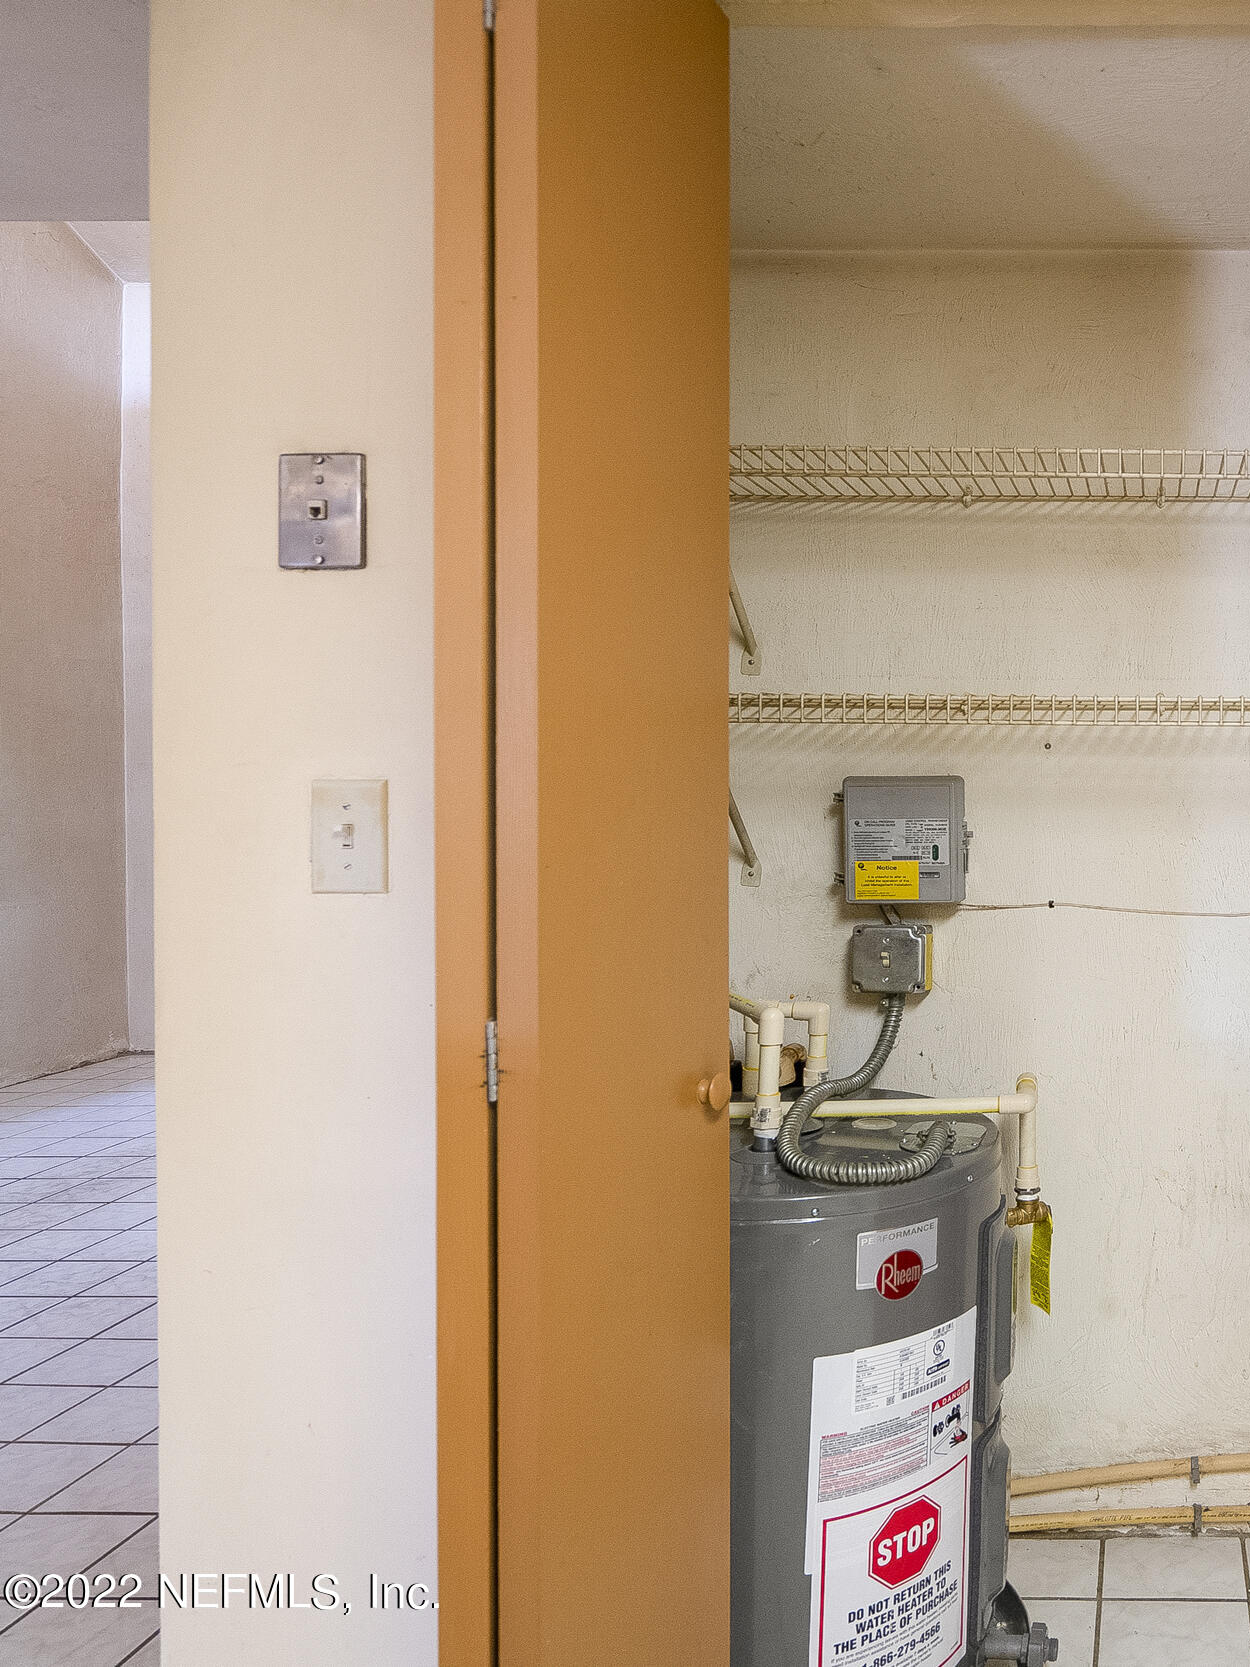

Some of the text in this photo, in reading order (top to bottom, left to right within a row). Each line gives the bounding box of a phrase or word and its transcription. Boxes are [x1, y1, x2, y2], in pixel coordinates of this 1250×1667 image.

[861, 1222, 935, 1246] PERFORMANCE
[881, 1252, 921, 1295] Rheem
[941, 1383, 969, 1406] DANGER
[876, 1517, 935, 1567] STOP
[833, 1638, 857, 1655] THE
[861, 1621, 897, 1647] PLACE
[900, 1612, 913, 1629] OF
[916, 1579, 958, 1620] PURCHASE
[848, 1608, 864, 1624] DO
[868, 1597, 890, 1617] NOT
[893, 1575, 931, 1605] RETURN
[934, 1560, 951, 1580] THIS
[855, 1610, 894, 1634] WATER
[898, 1585, 933, 1616] HEATER
[936, 1577, 946, 1594] TO
